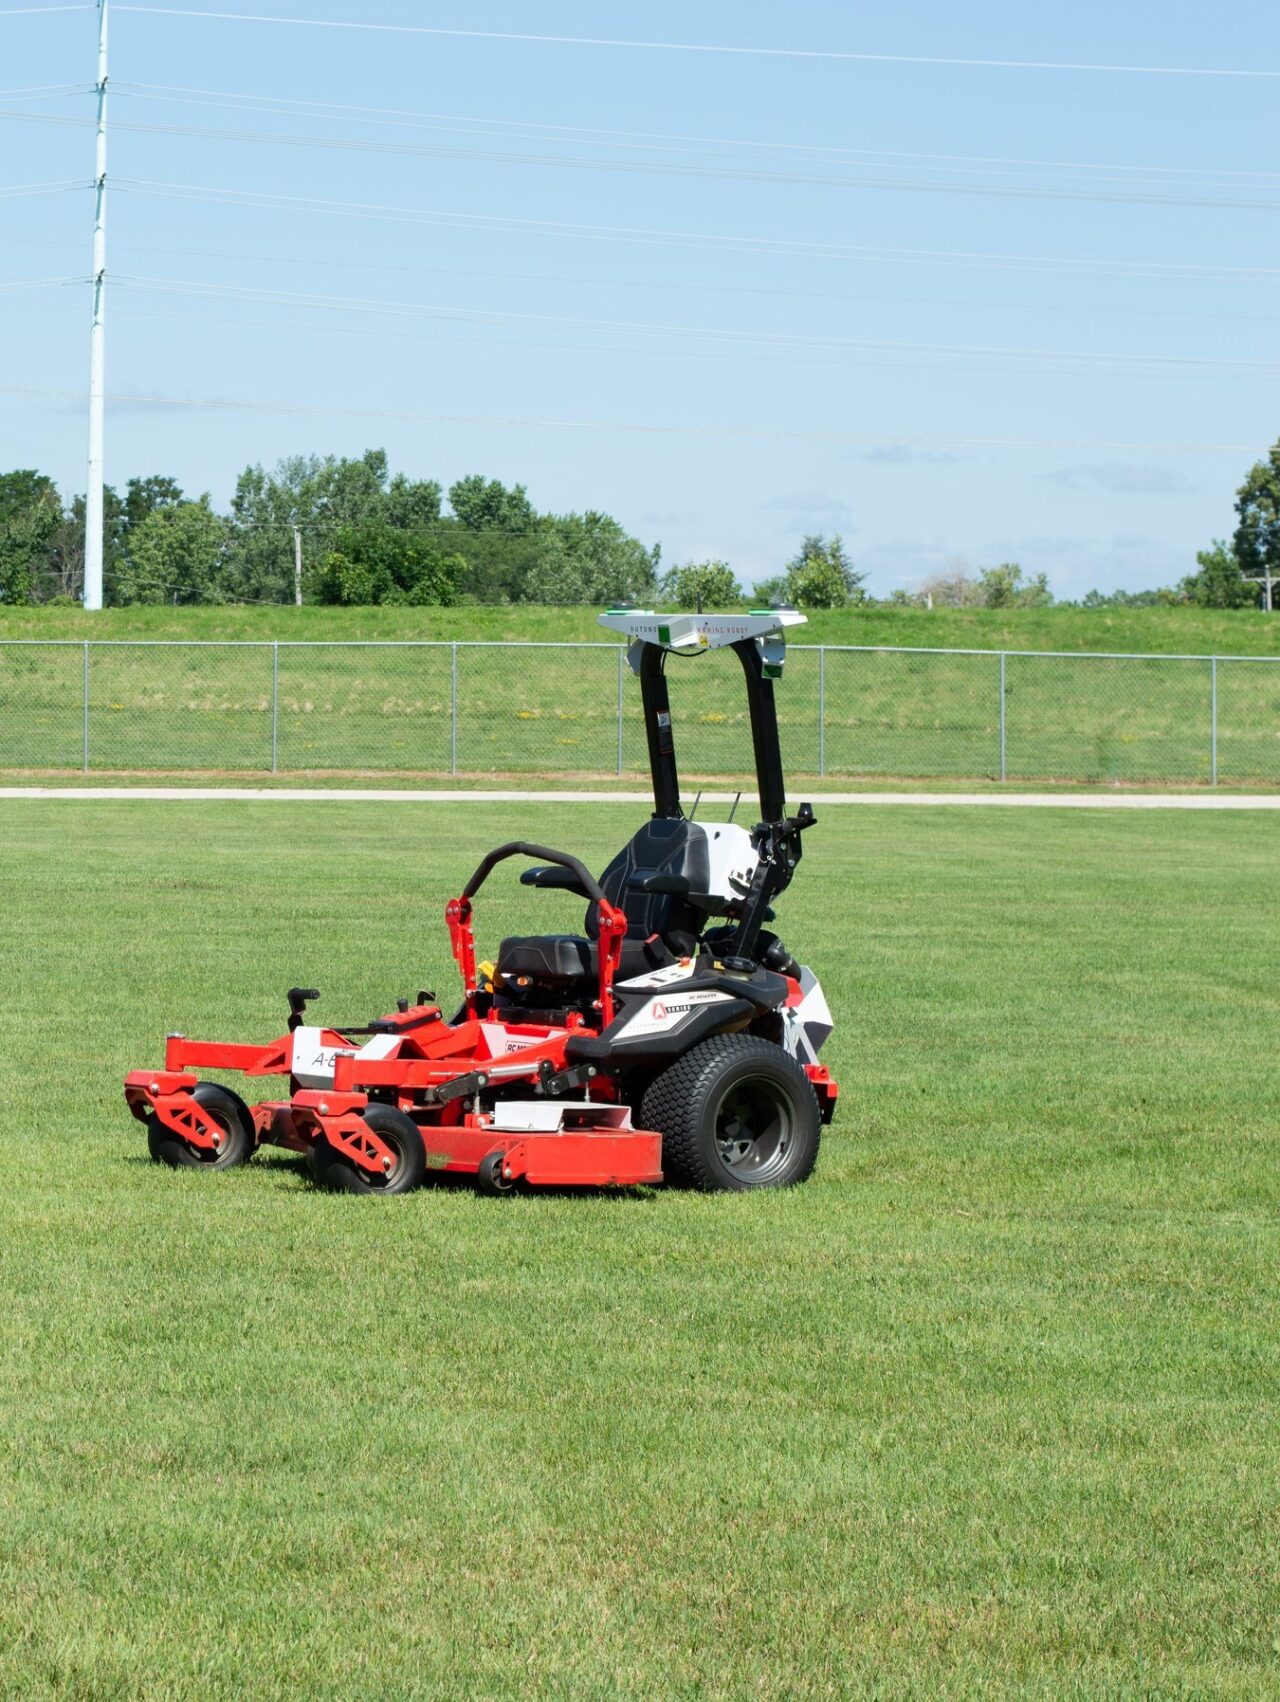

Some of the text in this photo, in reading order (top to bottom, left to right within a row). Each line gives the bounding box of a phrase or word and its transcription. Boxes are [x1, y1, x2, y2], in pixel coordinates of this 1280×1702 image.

[667, 1004, 691, 1013] SERIES
[507, 1044, 517, 1052] RC
[311, 1052, 335, 1068] A-6
